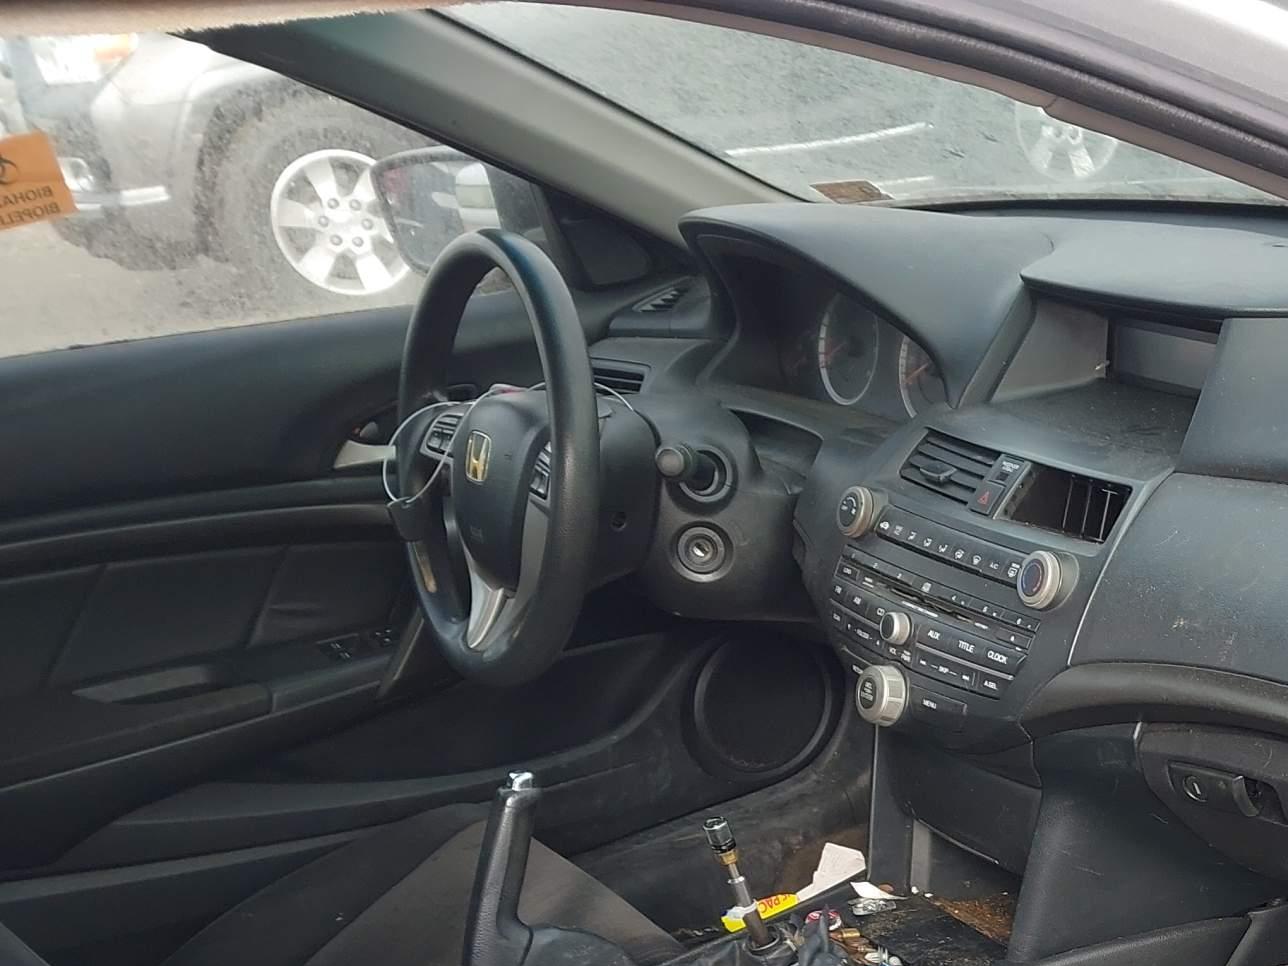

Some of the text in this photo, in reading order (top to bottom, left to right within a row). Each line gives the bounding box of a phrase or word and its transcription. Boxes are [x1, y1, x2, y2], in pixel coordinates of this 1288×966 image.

[927, 629, 941, 641] AUX
[958, 640, 975, 653] TITLE
[987, 650, 1008, 664] CLOCK
[922, 698, 937, 709] MENU
